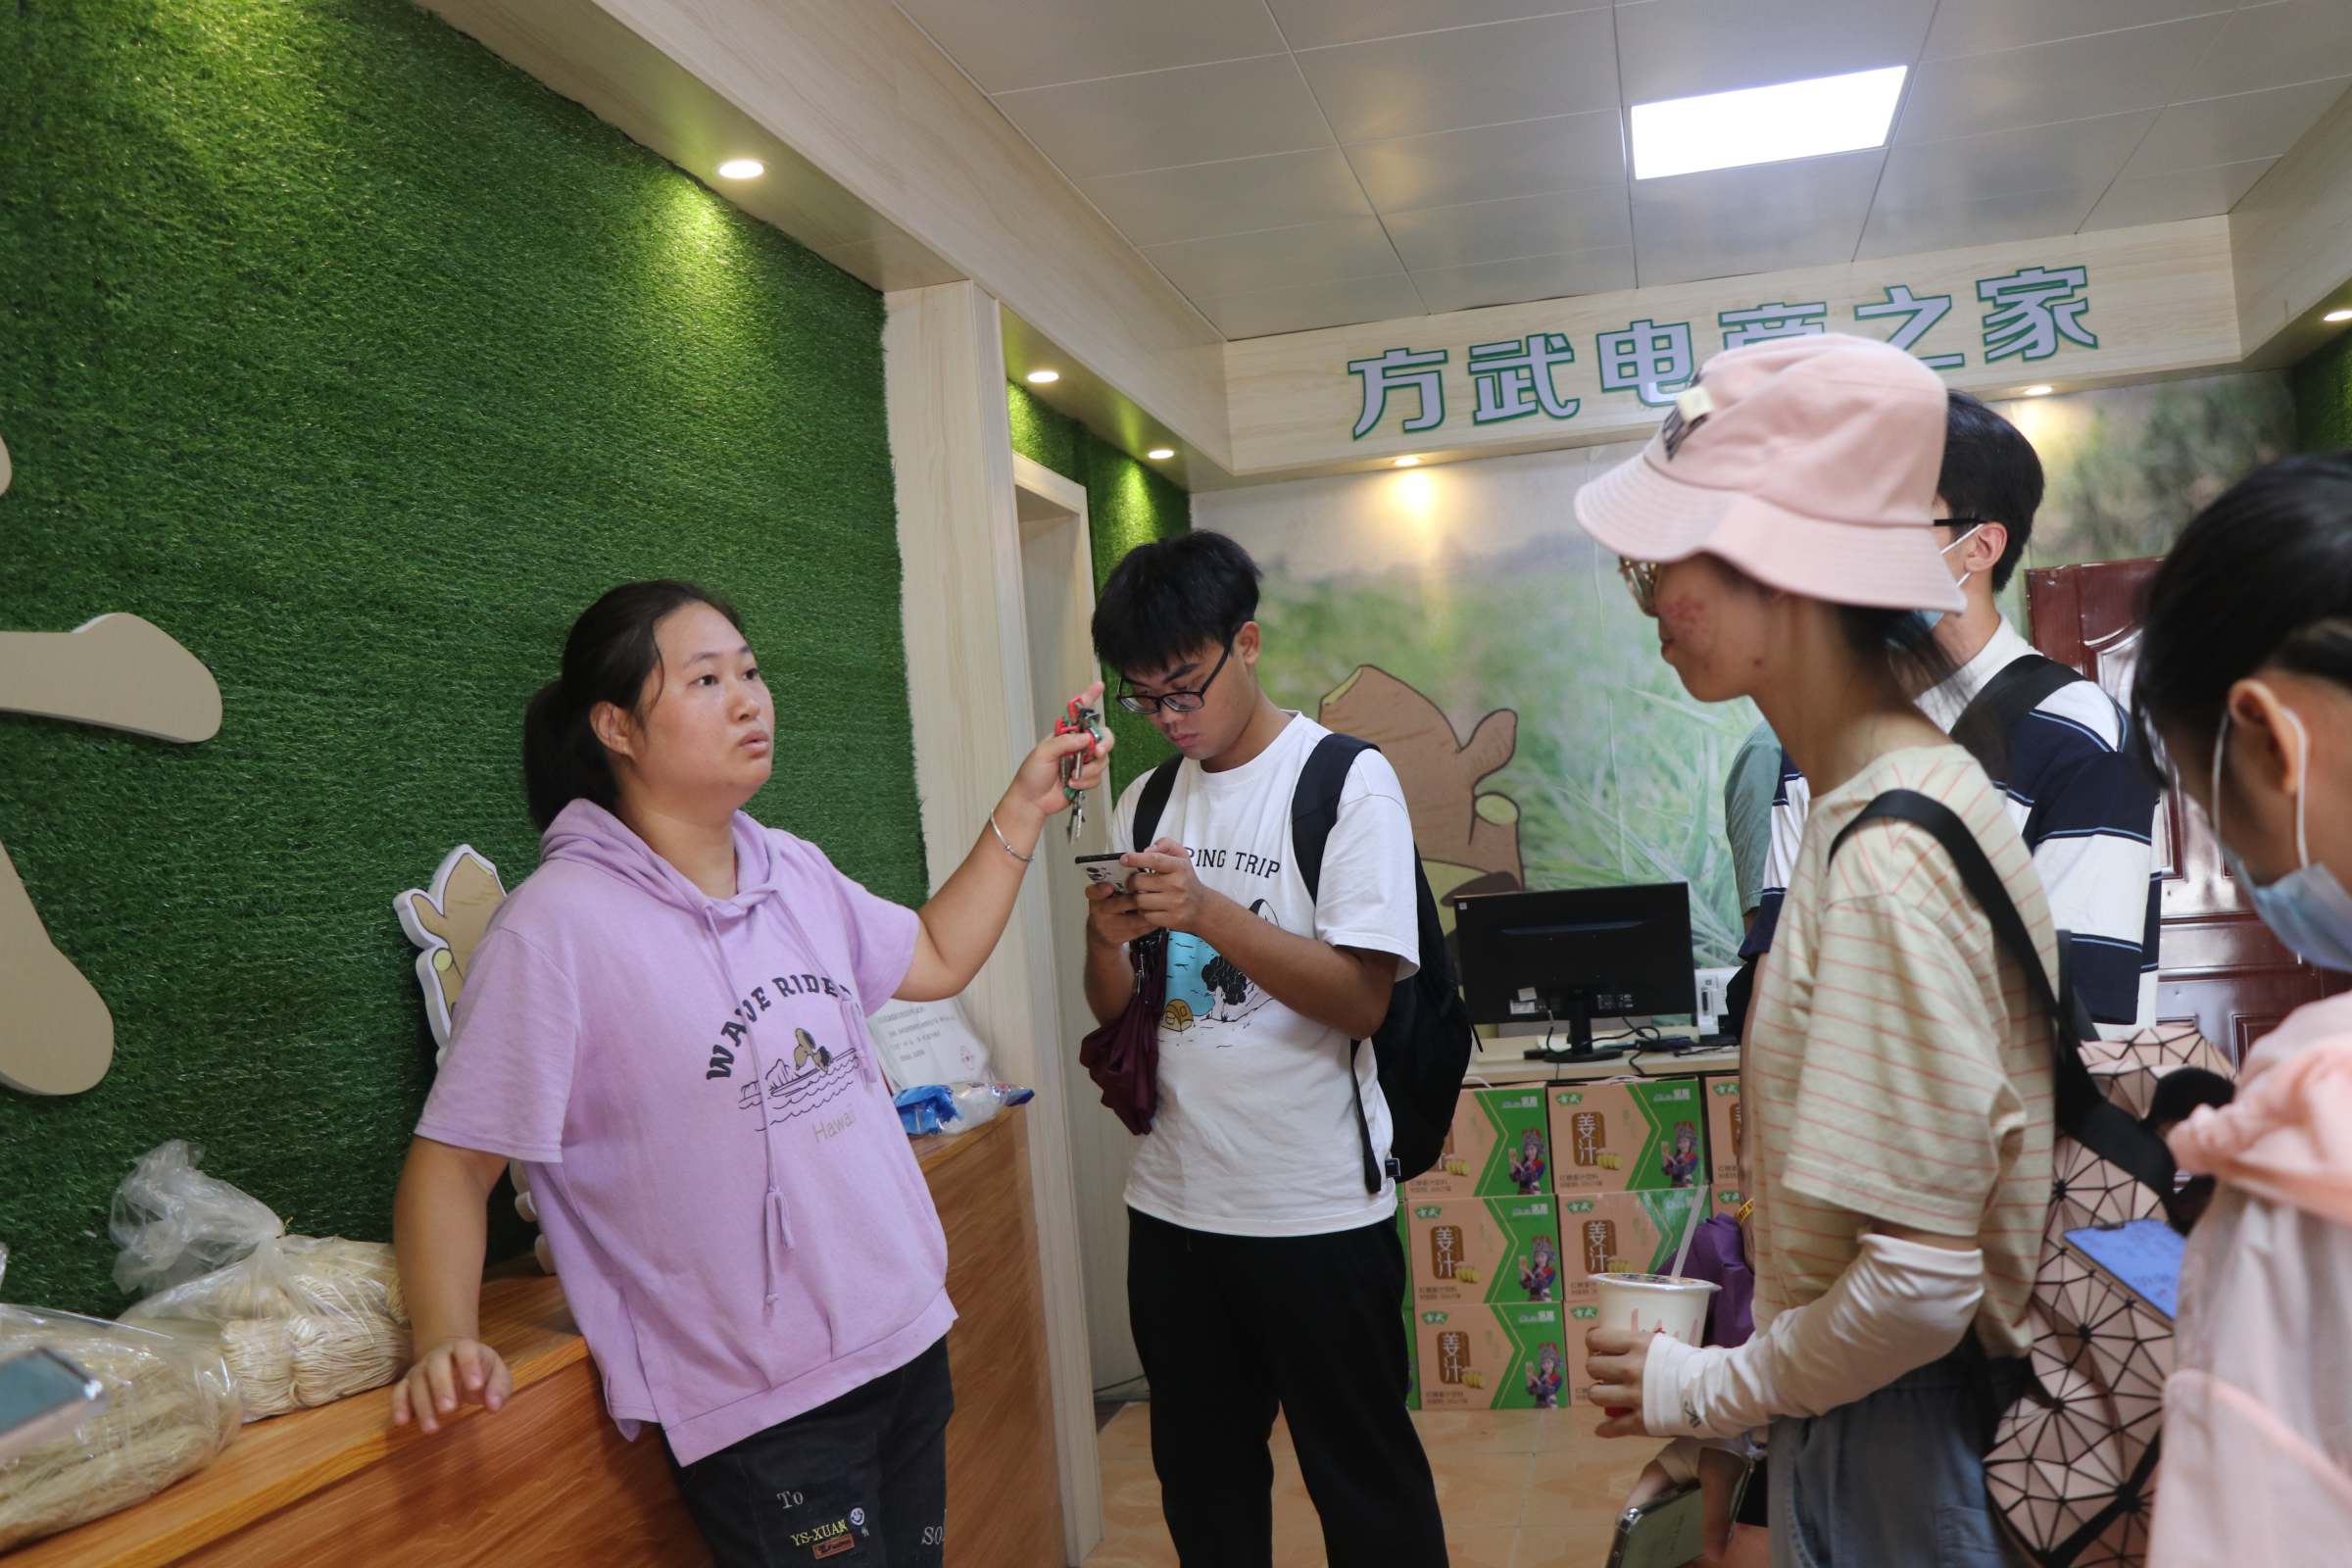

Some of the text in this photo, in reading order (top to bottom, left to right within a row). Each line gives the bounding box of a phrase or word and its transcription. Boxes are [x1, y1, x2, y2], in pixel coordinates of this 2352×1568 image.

[1235, 851, 1281, 879] TRIP
[706, 973, 853, 1080] WAVE RIDE
[1577, 1112, 1597, 1165] 姜汁
[1436, 1226, 1455, 1278] 姜汁
[1588, 1221, 1608, 1273] 姜汁
[1442, 1332, 1462, 1383] 姜汁
[776, 1490, 805, 1510] To
[790, 1518, 848, 1546] YS-XUAN
